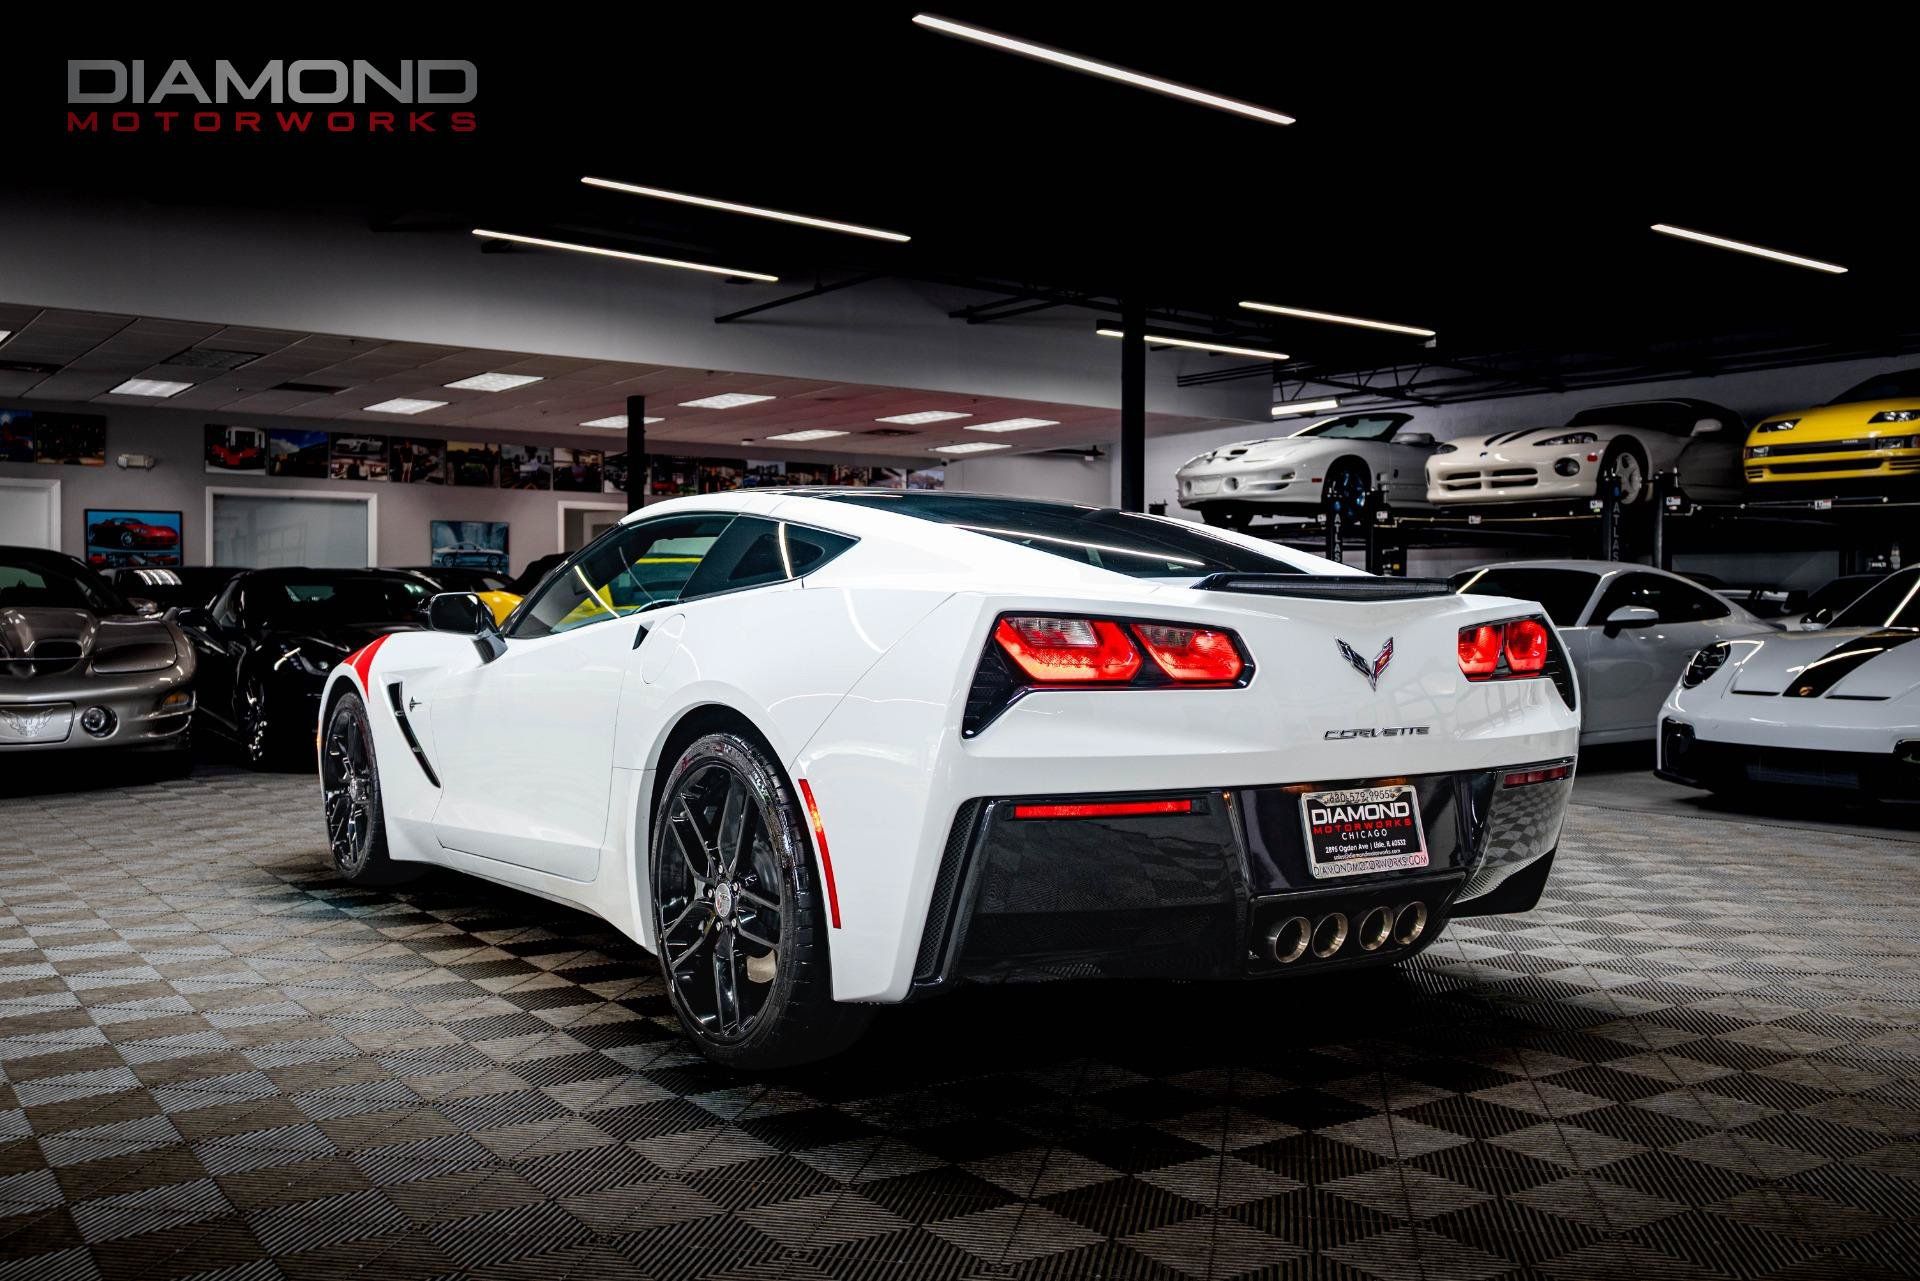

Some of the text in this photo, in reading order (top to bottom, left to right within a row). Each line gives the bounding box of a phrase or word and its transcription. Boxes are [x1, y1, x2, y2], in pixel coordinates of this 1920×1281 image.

[1324, 727, 1430, 740] CORVETTE
[1311, 801, 1410, 825] DIAMOND
[1313, 818, 1412, 835] MOTORWORKS
[1341, 829, 1388, 840] CHICAGO
[1338, 845, 1358, 853] Ogden
